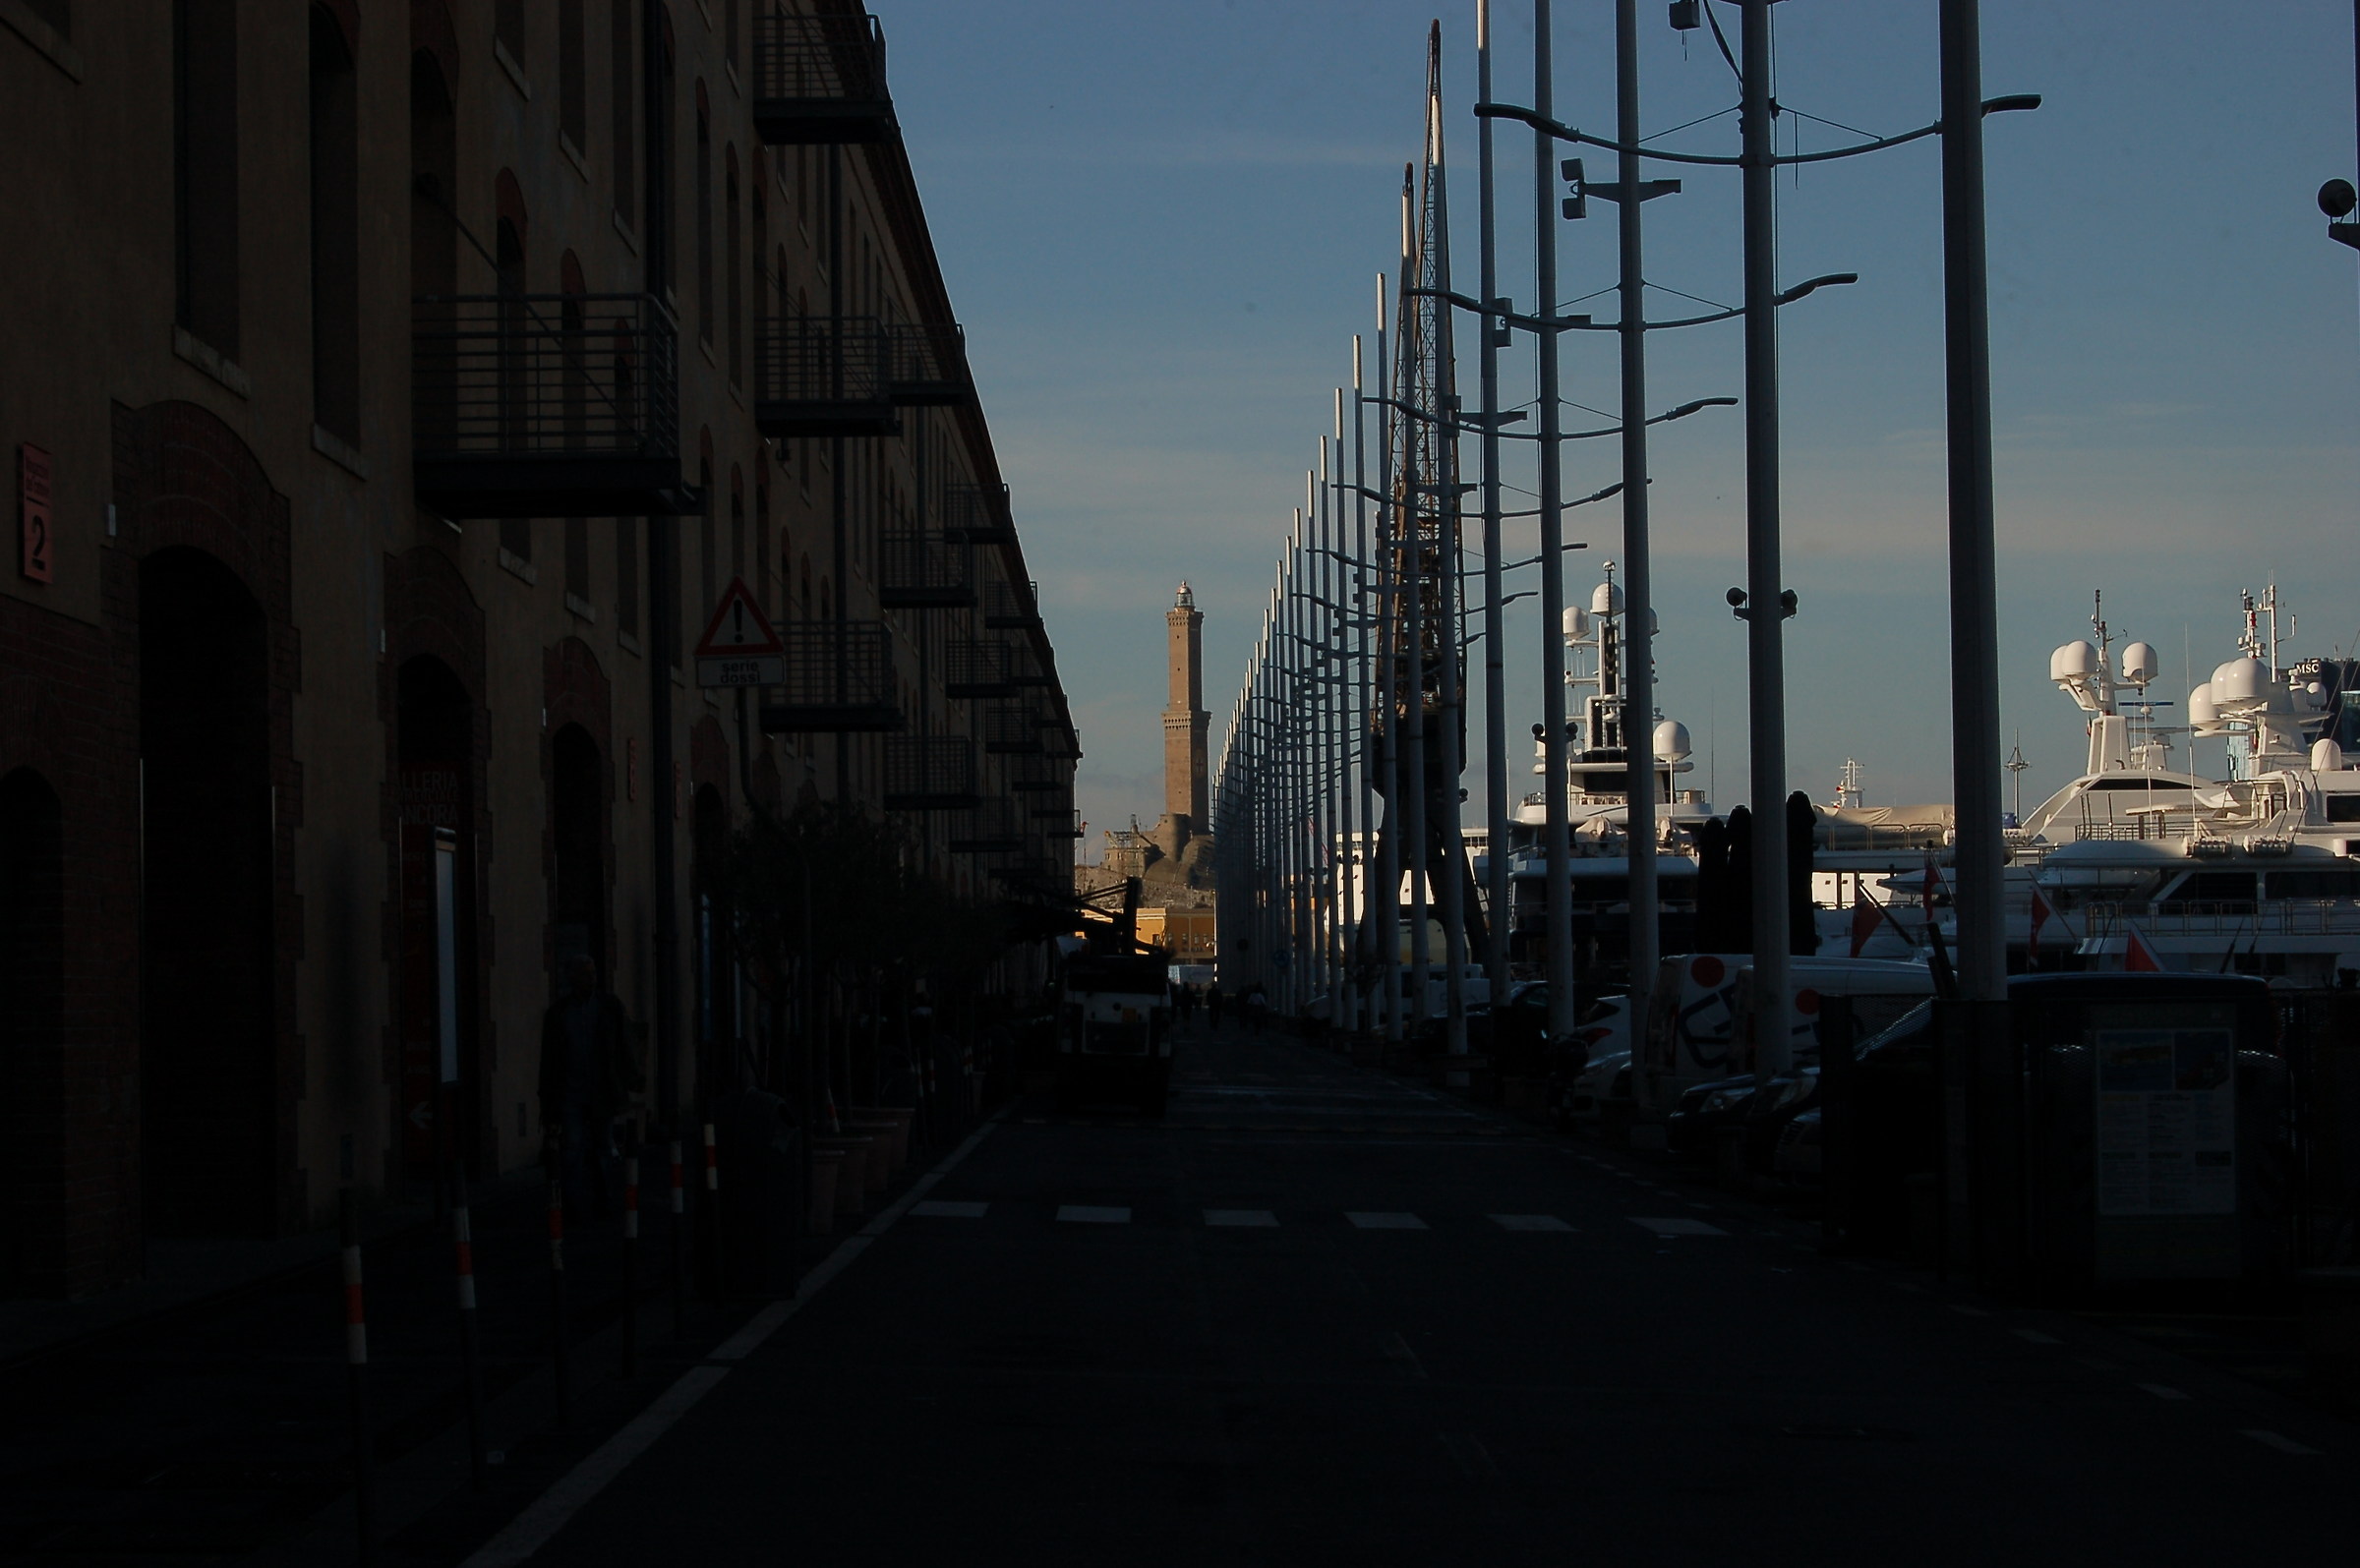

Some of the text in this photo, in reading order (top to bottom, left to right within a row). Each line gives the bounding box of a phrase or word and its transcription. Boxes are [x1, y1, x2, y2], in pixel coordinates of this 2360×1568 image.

[31, 514, 46, 570] 2
[722, 660, 759, 672] serie
[2295, 663, 2320, 674] MSC
[720, 670, 761, 684] dossi
